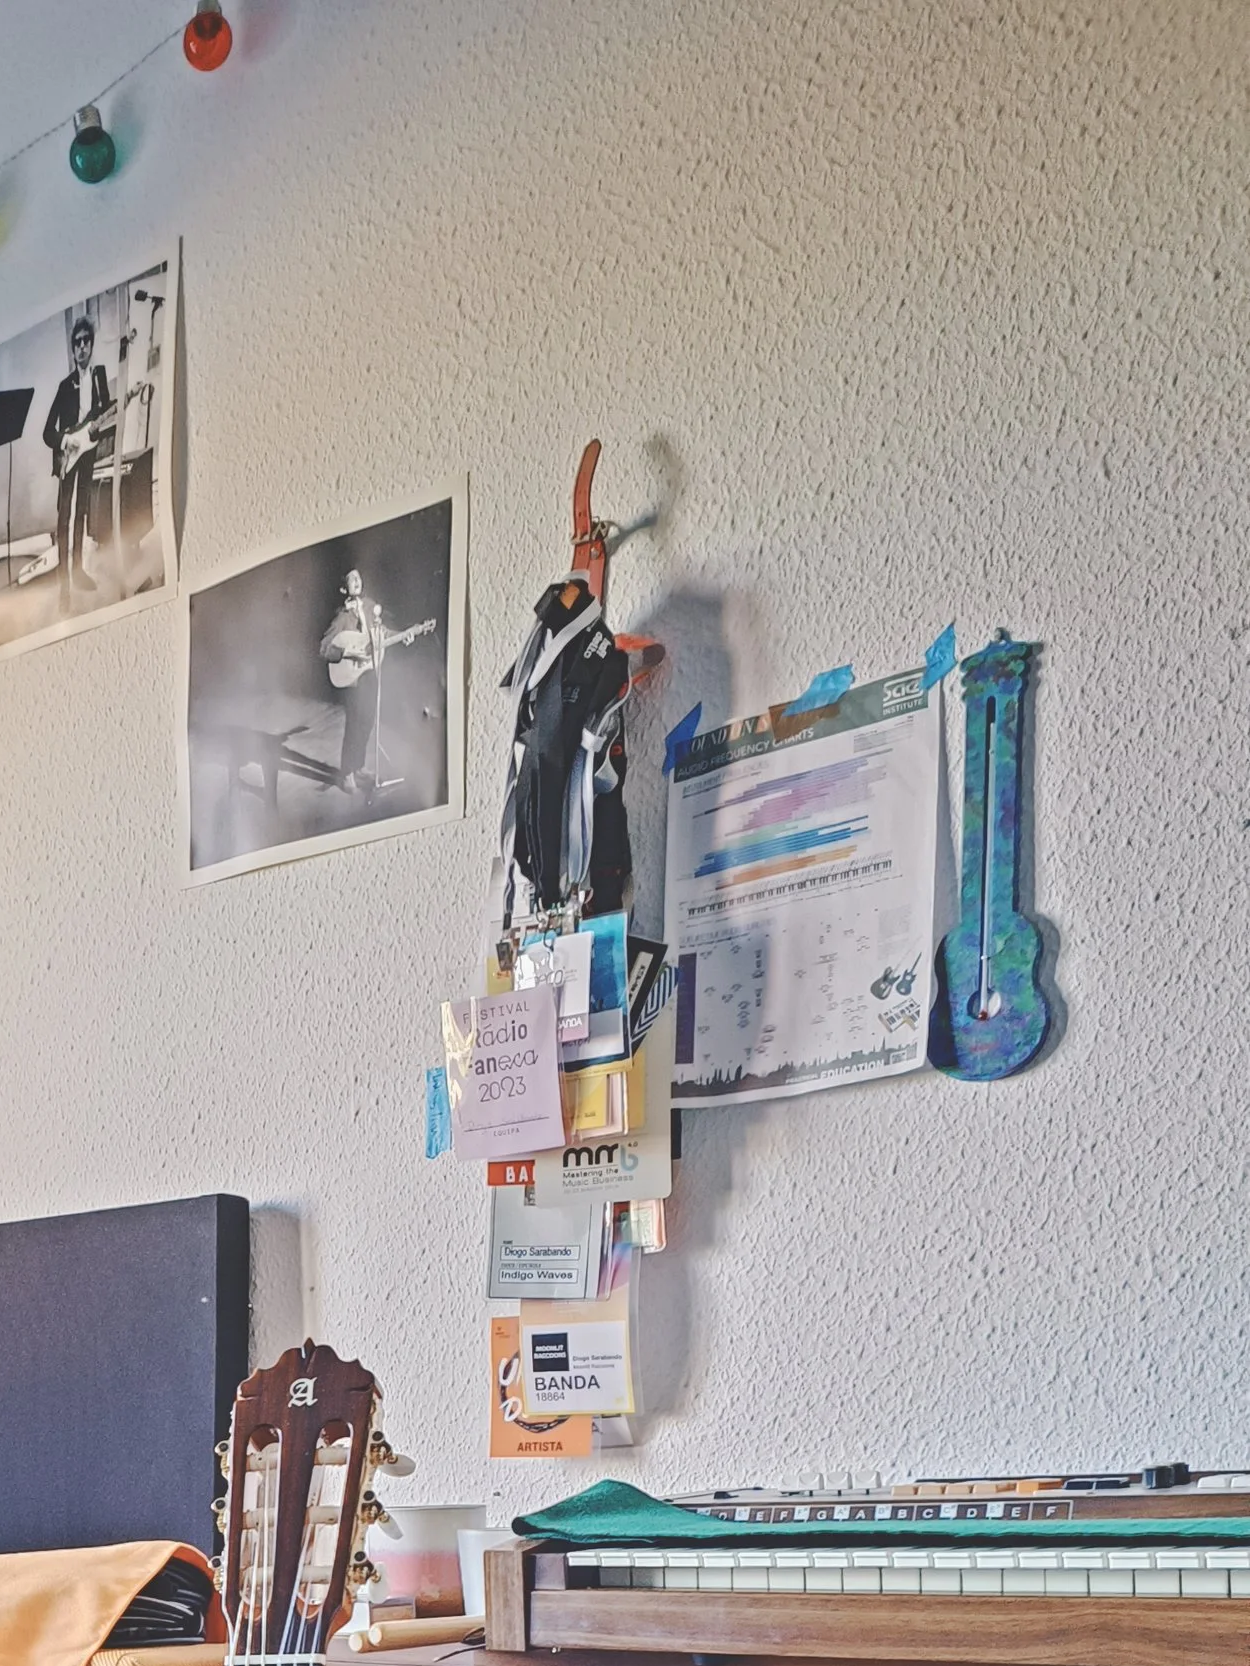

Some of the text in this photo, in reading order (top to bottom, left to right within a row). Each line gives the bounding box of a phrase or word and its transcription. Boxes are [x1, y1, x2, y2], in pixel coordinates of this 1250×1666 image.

[883, 699, 923, 716] INSTITUTE
[691, 728, 727, 753] OUND
[677, 760, 708, 778] AUDIO
[709, 739, 770, 768] FREQUENCY
[462, 1000, 530, 1024] FSTIVAL
[469, 1049, 539, 1075] aneca
[820, 1059, 885, 1080] EDUCATION
[478, 1076, 526, 1102] 2023
[505, 1165, 536, 1184] BA
[562, 1174, 634, 1188] Music Business
[504, 1246, 572, 1258] Diogo Sarabando
[501, 1269, 573, 1282] Indigo Waves
[534, 1375, 601, 1391] BANDA
[535, 1392, 565, 1402] 18864
[517, 1441, 564, 1453] ARTISTA
